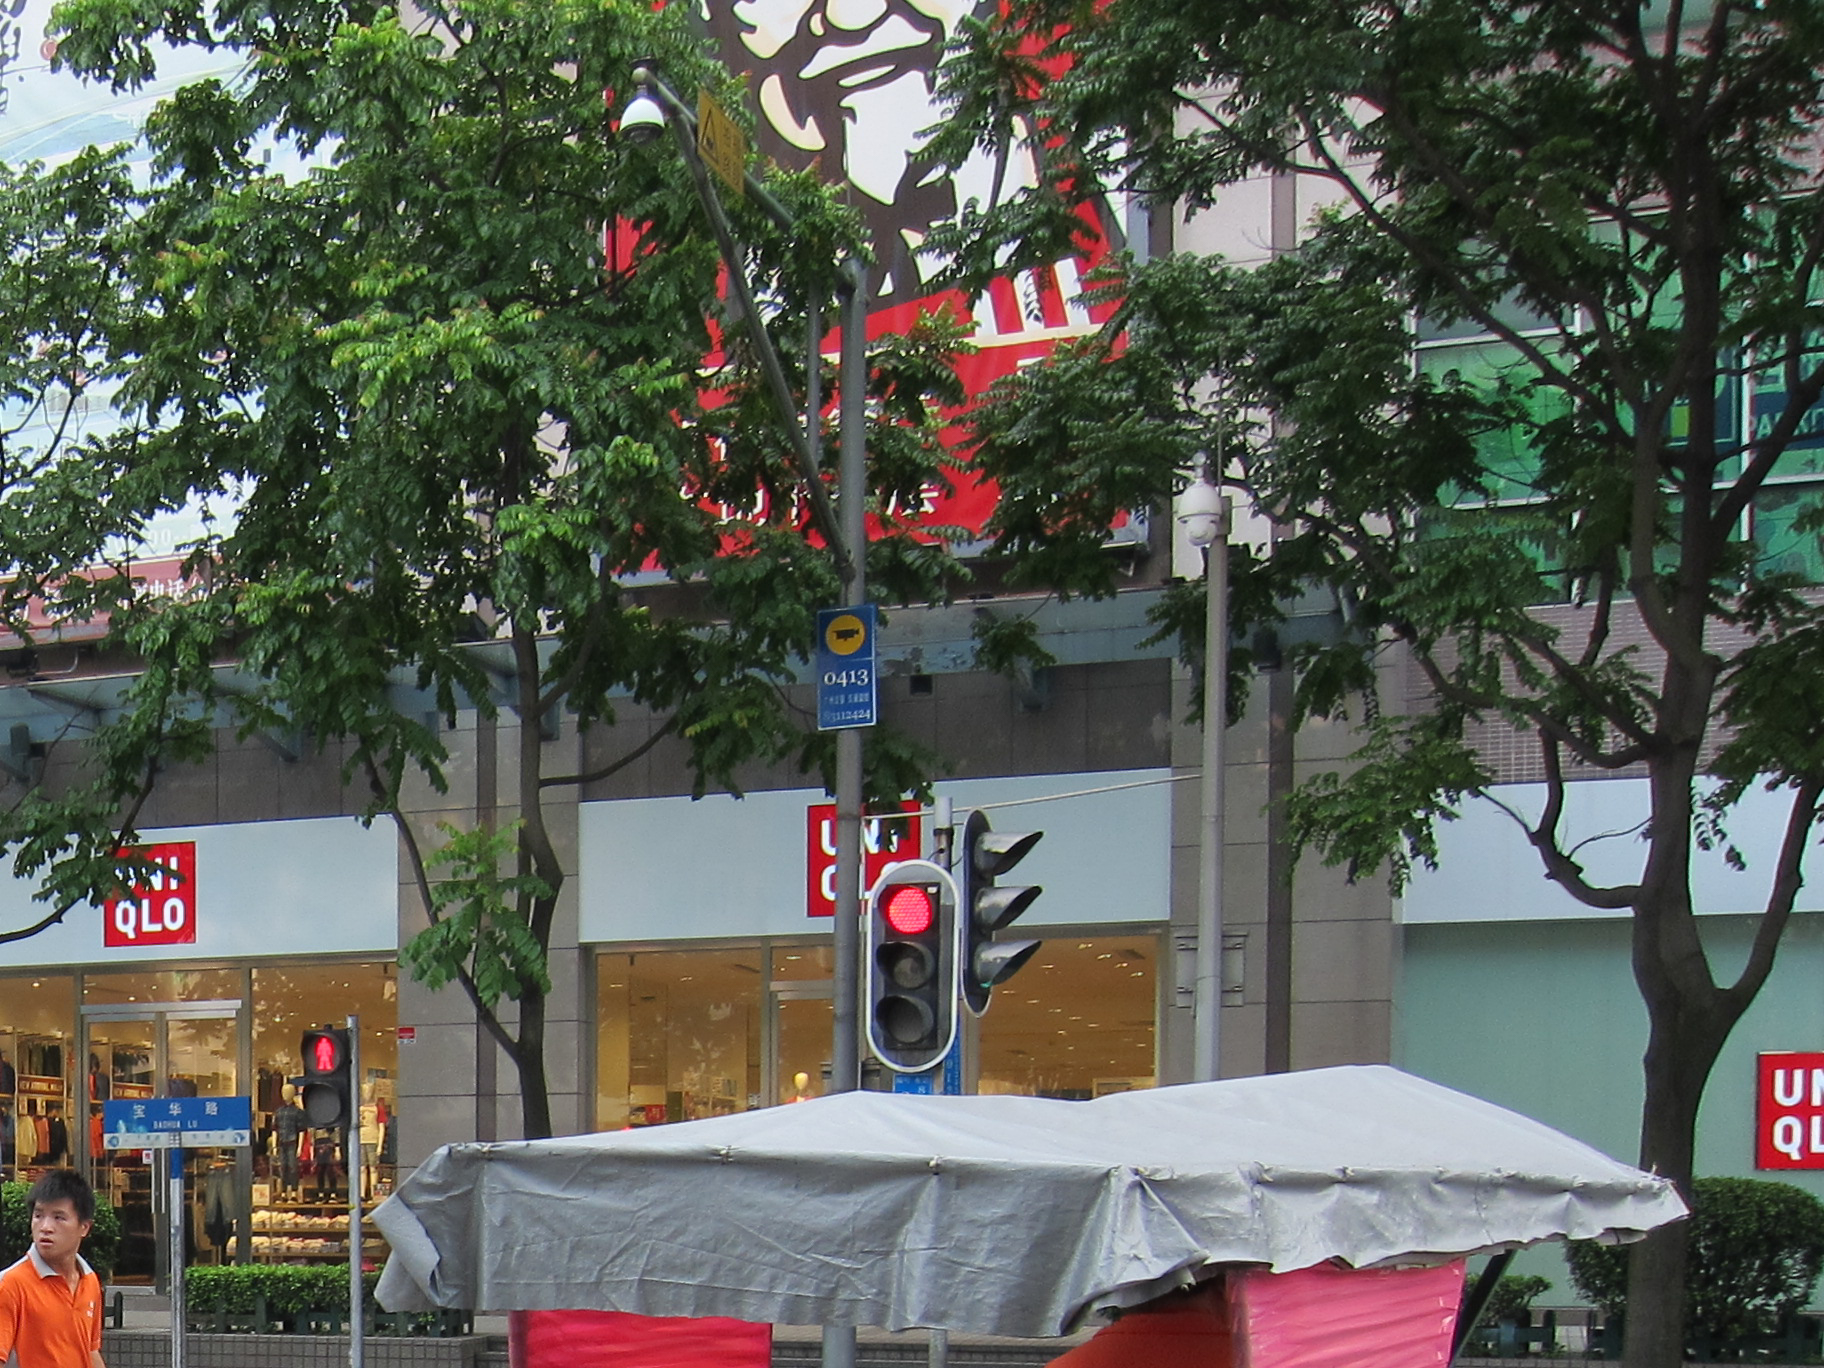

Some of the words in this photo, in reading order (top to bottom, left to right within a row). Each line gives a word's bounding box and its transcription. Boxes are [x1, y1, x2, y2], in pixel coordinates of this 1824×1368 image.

[824, 668, 869, 687] 0413
[115, 897, 185, 939] QLO
[133, 1101, 218, 1119] 宝华路
[188, 1120, 197, 1128] LU
